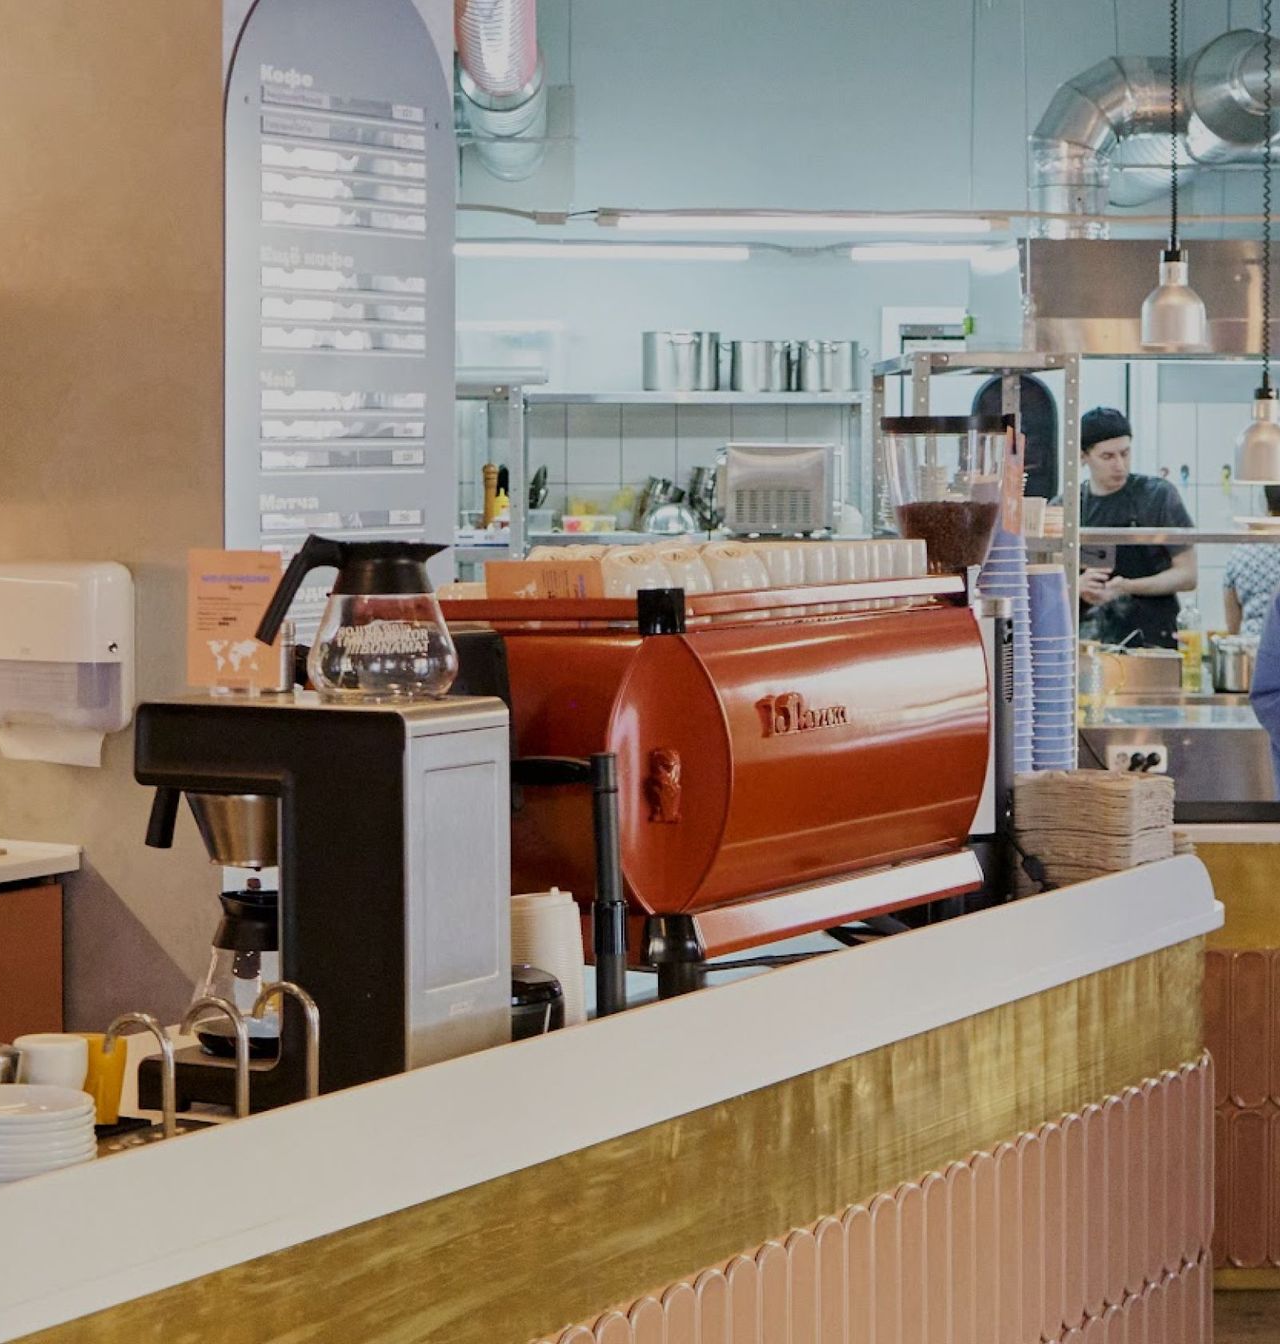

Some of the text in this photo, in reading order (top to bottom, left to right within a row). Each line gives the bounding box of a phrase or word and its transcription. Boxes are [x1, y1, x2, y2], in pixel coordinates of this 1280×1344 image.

[260, 63, 314, 88] Кофе
[303, 251, 355, 271] кофе
[260, 368, 296, 388] Чай
[259, 494, 320, 511] Матча
